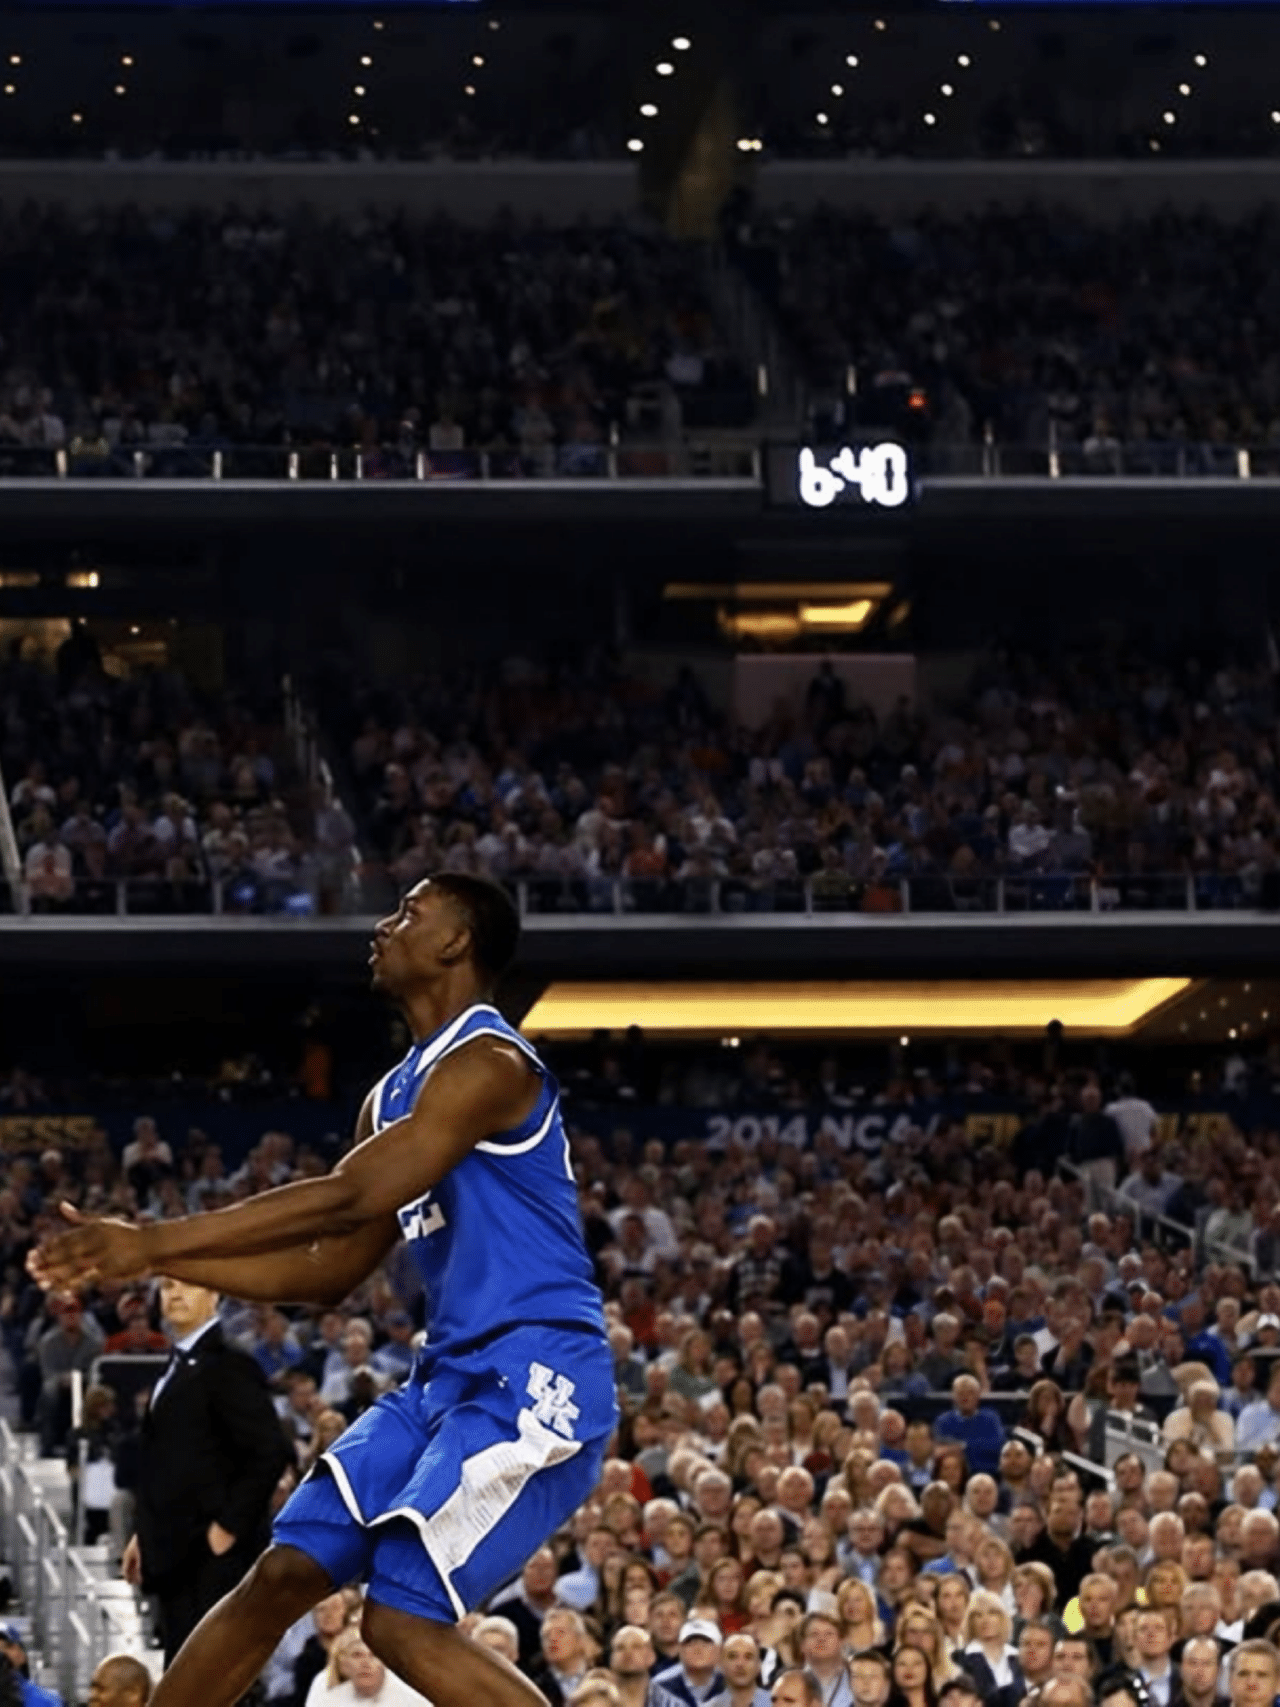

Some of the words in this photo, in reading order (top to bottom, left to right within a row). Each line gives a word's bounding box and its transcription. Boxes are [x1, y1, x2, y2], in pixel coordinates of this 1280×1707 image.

[799, 442, 908, 507] 6:40
[705, 1114, 808, 1151] 2014
[526, 1361, 581, 1440] UK
